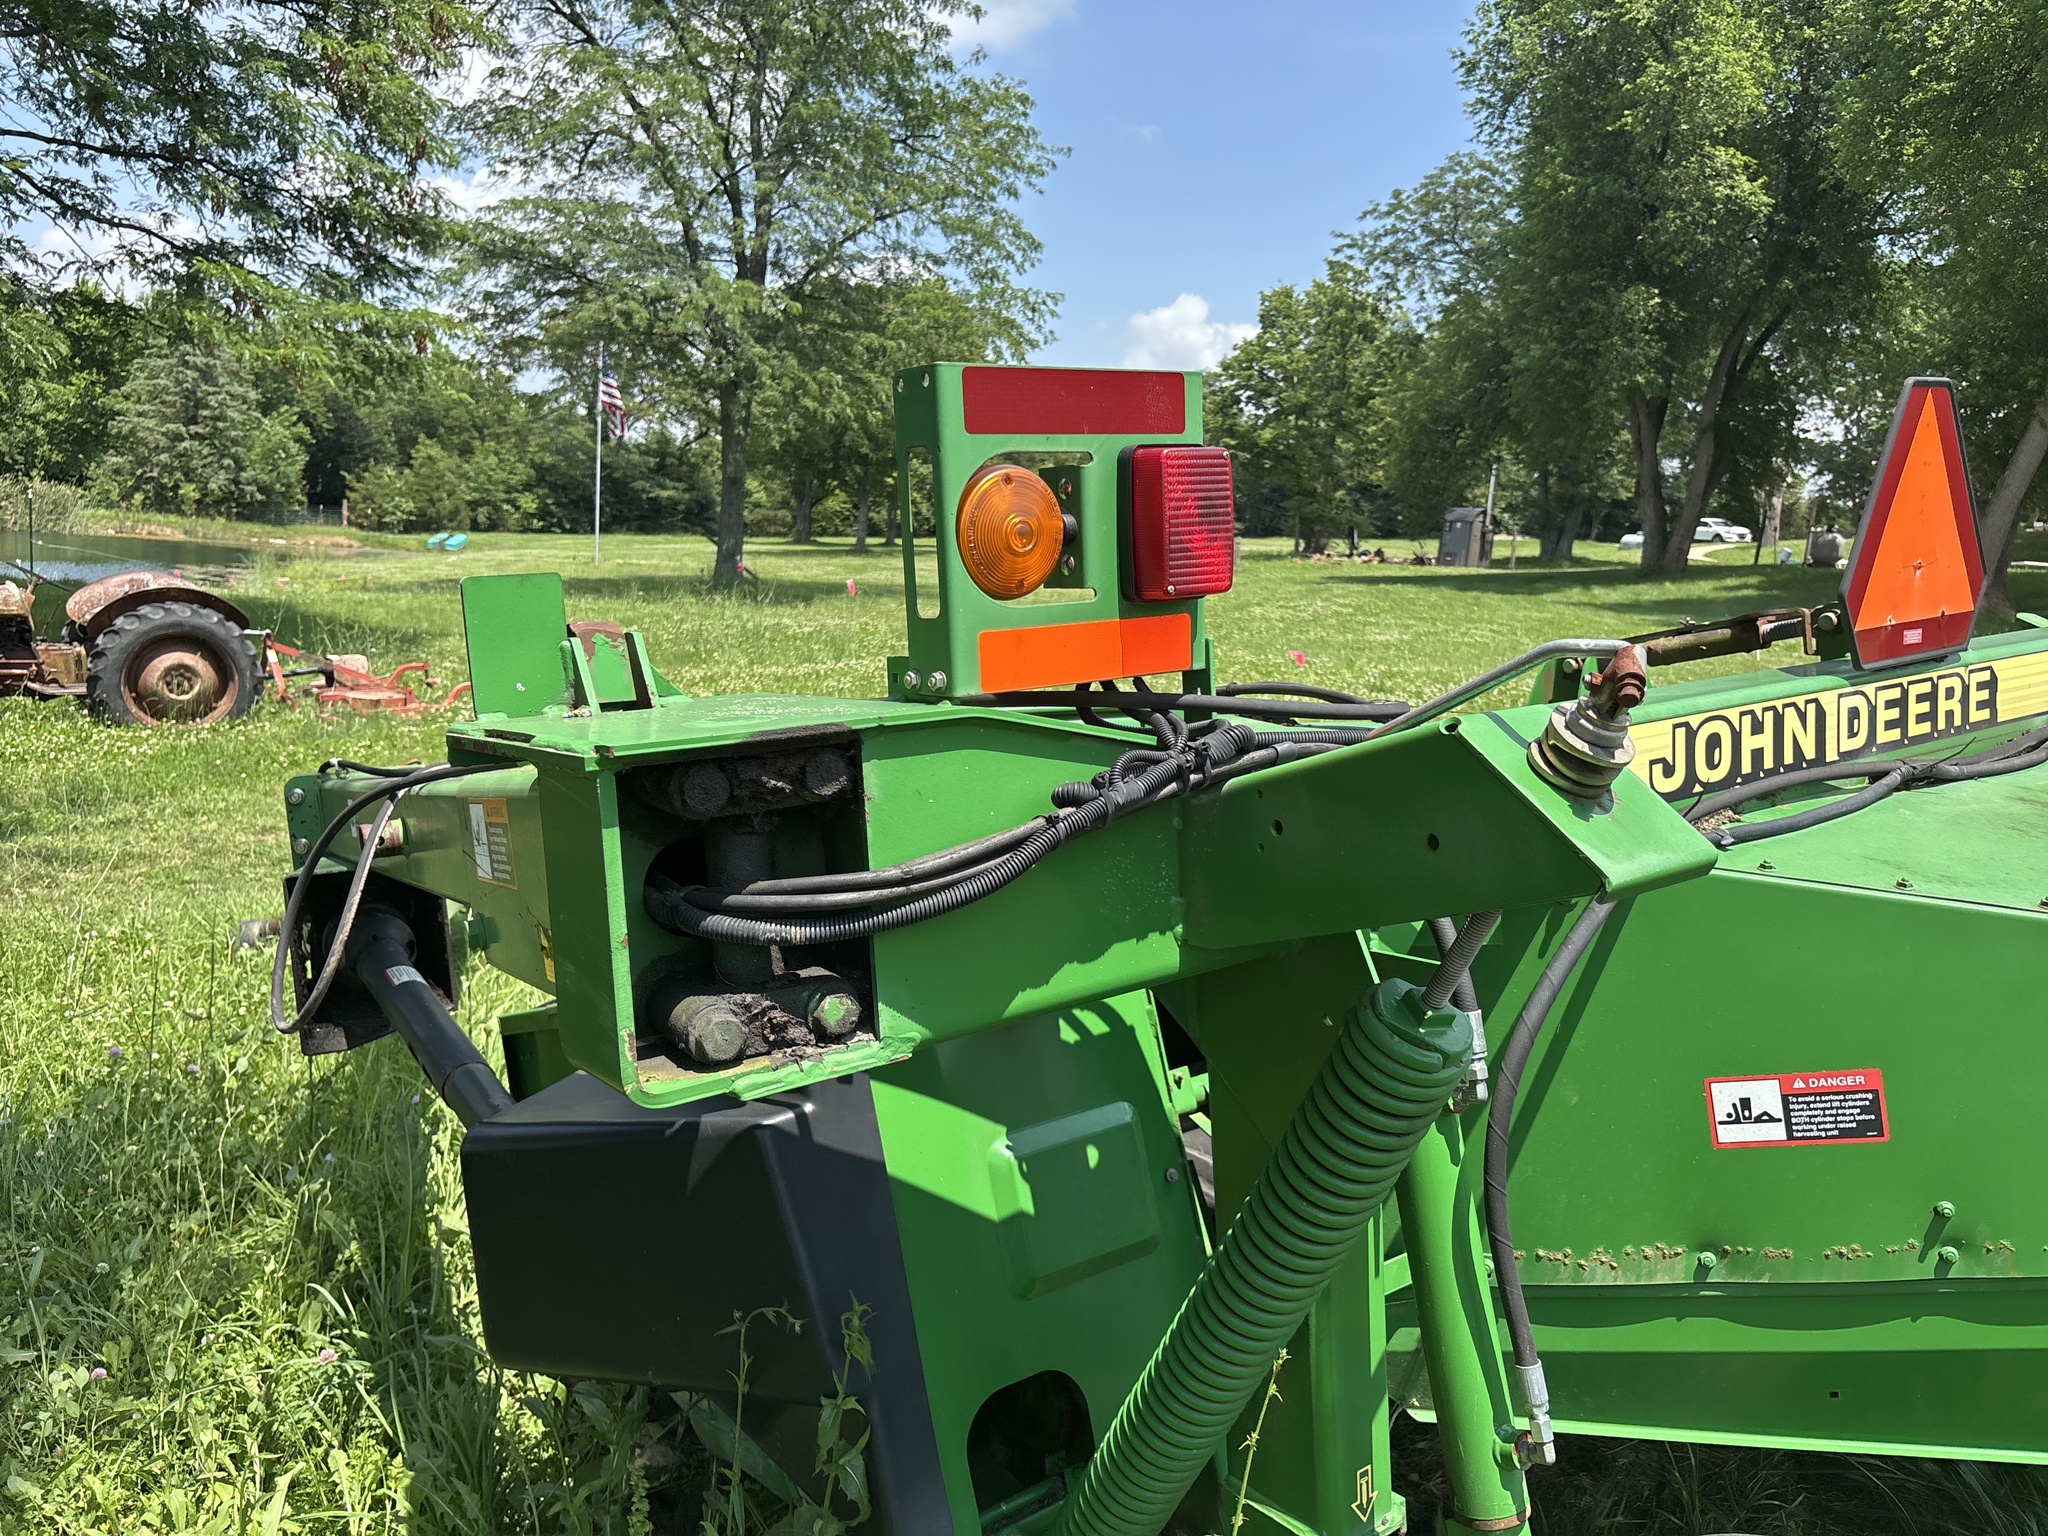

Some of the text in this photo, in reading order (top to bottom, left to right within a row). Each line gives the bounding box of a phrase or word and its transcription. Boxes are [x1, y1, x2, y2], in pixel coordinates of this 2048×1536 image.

[1649, 667, 1997, 796] JOHN DEERE
[1809, 1075, 1865, 1087] DANGER
[1841, 1100, 1869, 1108] cylinders
[1790, 1109, 1823, 1118] completely
